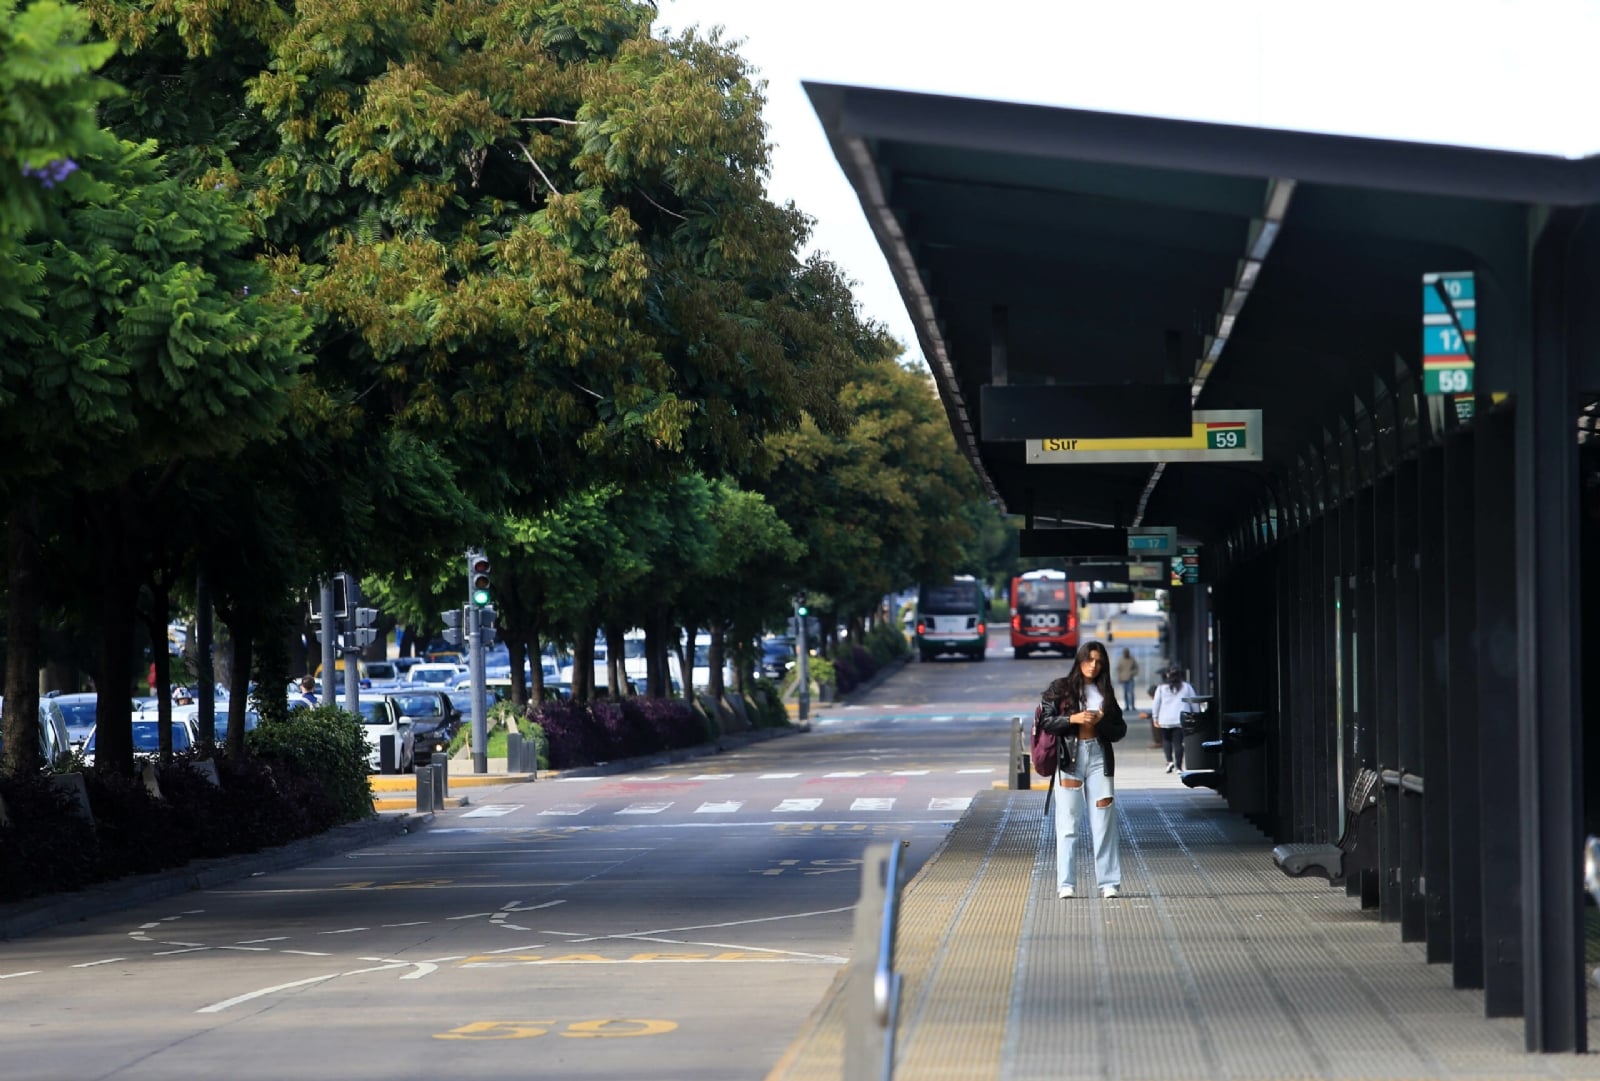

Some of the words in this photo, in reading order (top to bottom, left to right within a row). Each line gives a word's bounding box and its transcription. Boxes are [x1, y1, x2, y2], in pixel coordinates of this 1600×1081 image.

[1440, 329, 1462, 351] 17
[1439, 369, 1468, 393] 59
[1049, 438, 1078, 450] Sur
[1215, 431, 1238, 448] 59
[1025, 613, 1060, 628] 100
[431, 1018, 679, 1040] 59
